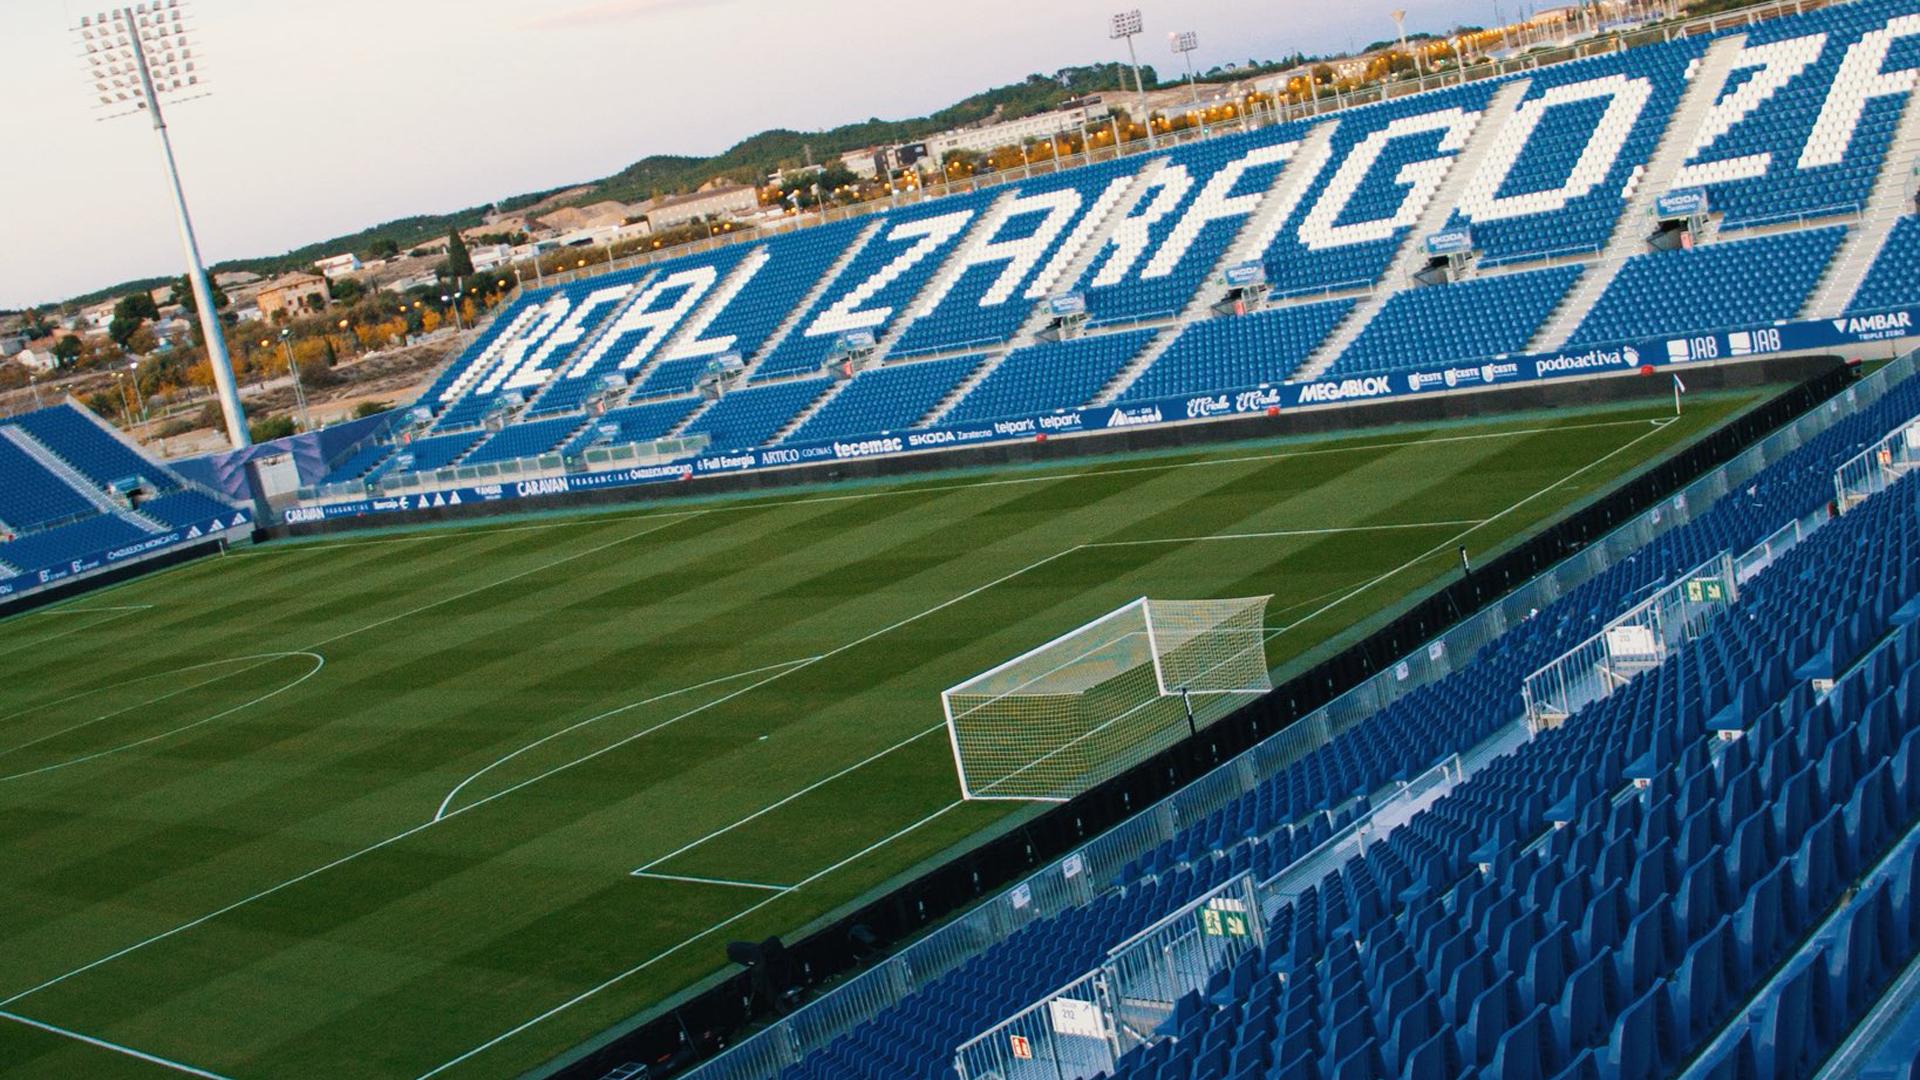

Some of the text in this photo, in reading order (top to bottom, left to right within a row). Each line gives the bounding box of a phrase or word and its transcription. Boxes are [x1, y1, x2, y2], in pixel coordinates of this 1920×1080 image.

[439, 252, 770, 402] REAL
[1848, 311, 1912, 333] AMBAR
[1689, 336, 1719, 360] JAB
[1752, 328, 1782, 353] JAB
[1456, 368, 1479, 378] CESTE
[1493, 363, 1518, 374] CESTE
[1536, 350, 1622, 377] podoactiva
[1419, 372, 1443, 382] CESTE
[1298, 375, 1392, 403] MEGABLOK
[994, 418, 1036, 436] telpark
[1039, 412, 1082, 431] telpark
[834, 436, 904, 458] tecemac
[908, 432, 956, 446] SKODA
[802, 445, 832, 458] COCINAS
[517, 473, 630, 497] CARAVAN FRAGANCIAS
[285, 507, 325, 524] CARAVAN
